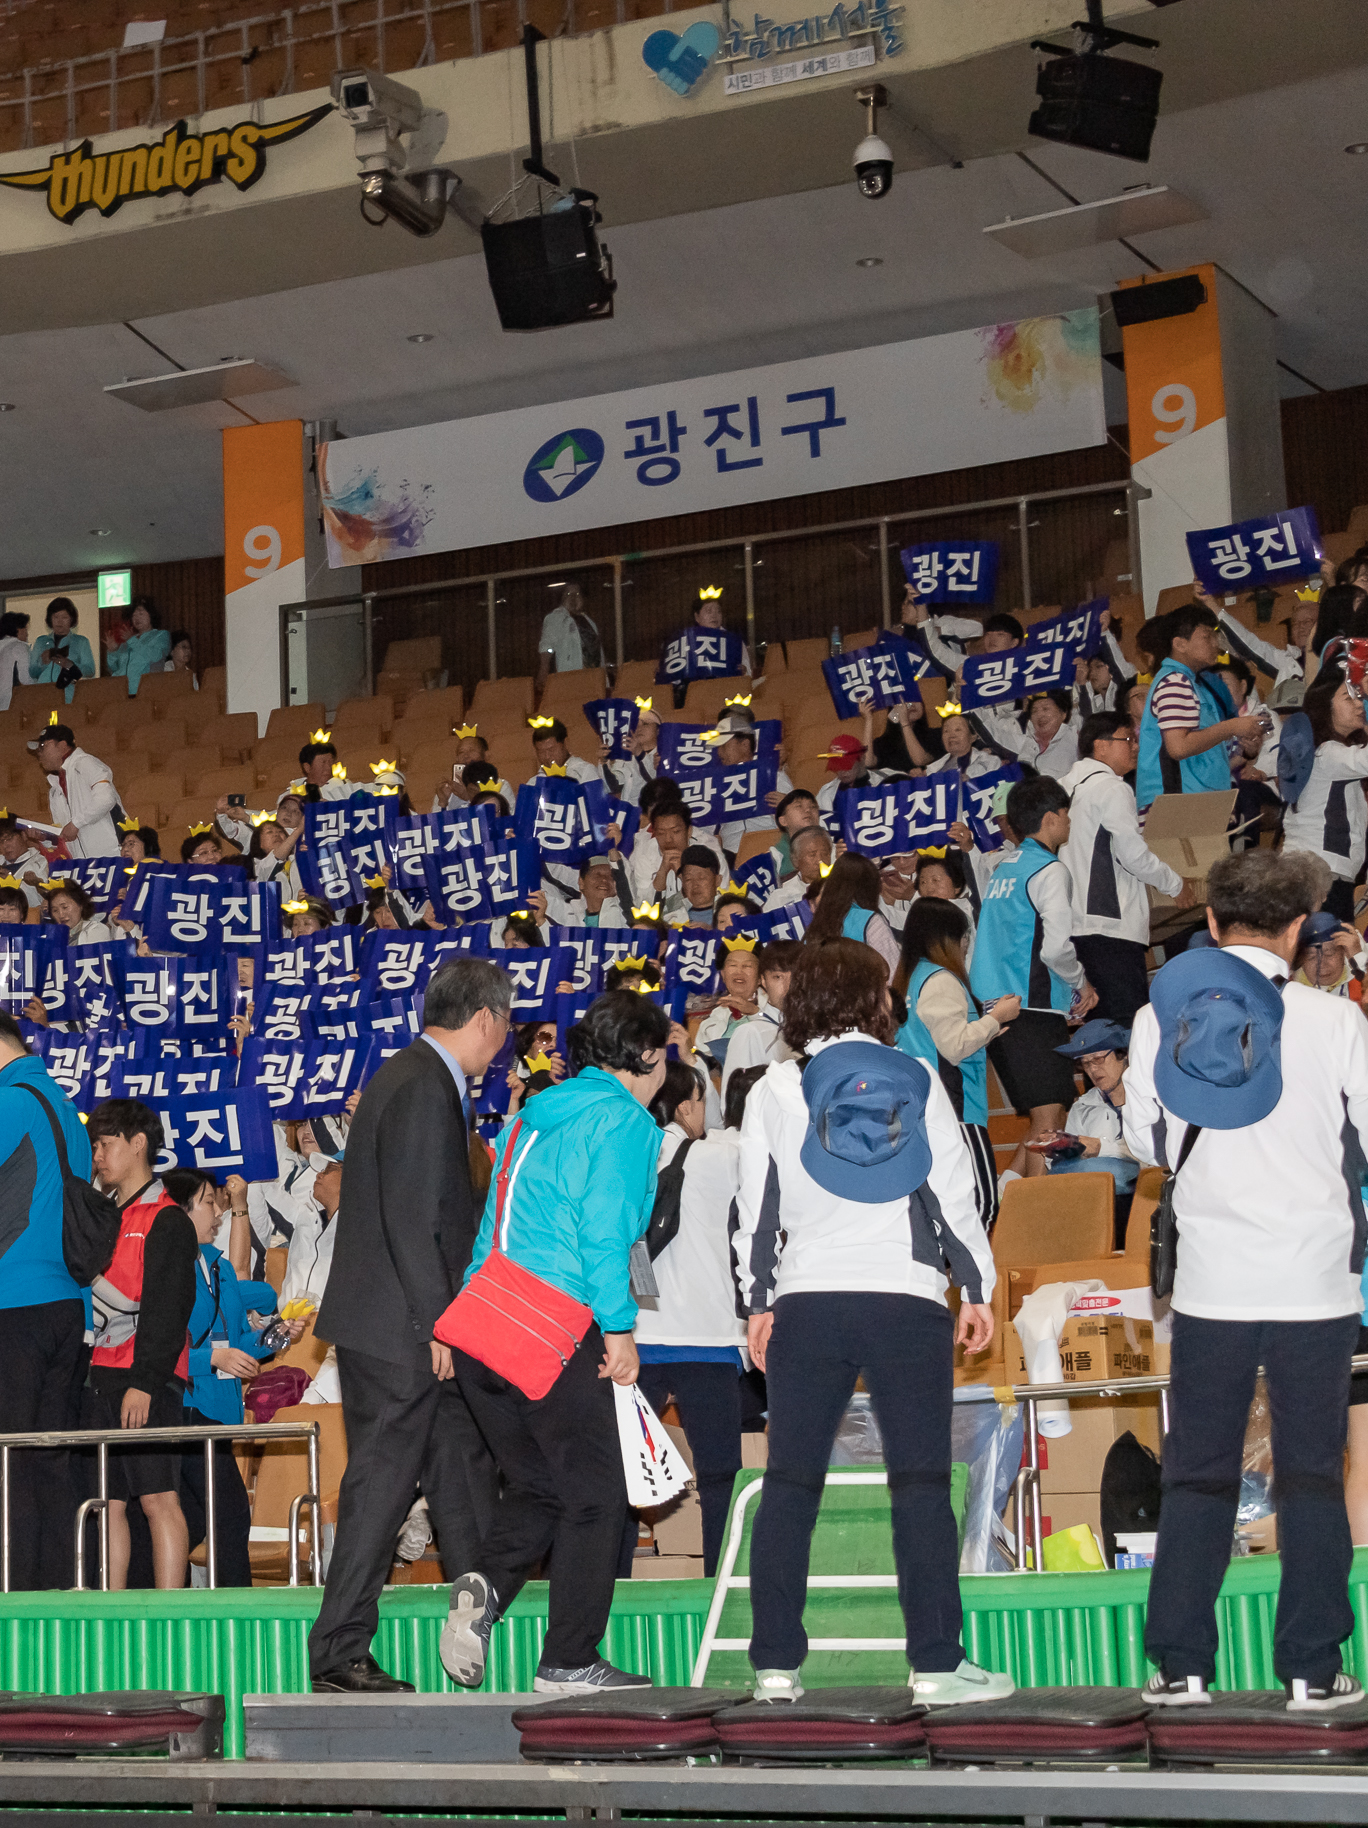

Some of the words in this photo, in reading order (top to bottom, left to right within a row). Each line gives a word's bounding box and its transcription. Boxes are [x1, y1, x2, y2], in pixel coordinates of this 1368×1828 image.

[728, 71, 769, 91] 시민과
[771, 64, 798, 84] 함께
[801, 57, 842, 77] 세계와
[845, 50, 875, 70] 함께
[48, 119, 268, 226] thunders
[624, 387, 846, 485] 광진구
[1151, 384, 1196, 443] 9
[243, 525, 282, 579] 9
[912, 551, 981, 594] 광진
[1208, 521, 1301, 580] 광진
[665, 635, 727, 675] 광진
[838, 652, 905, 704] 광진
[974, 648, 1064, 697] 광진
[679, 769, 757, 819] 광진
[853, 784, 947, 847] 광진
[441, 850, 519, 911] 광진
[168, 893, 262, 943] 광진
[265, 935, 360, 985] 광진
[126, 968, 219, 1026] 광진
[255, 1049, 356, 1107] 광진
[1113, 1352, 1151, 1373] 파인애플
